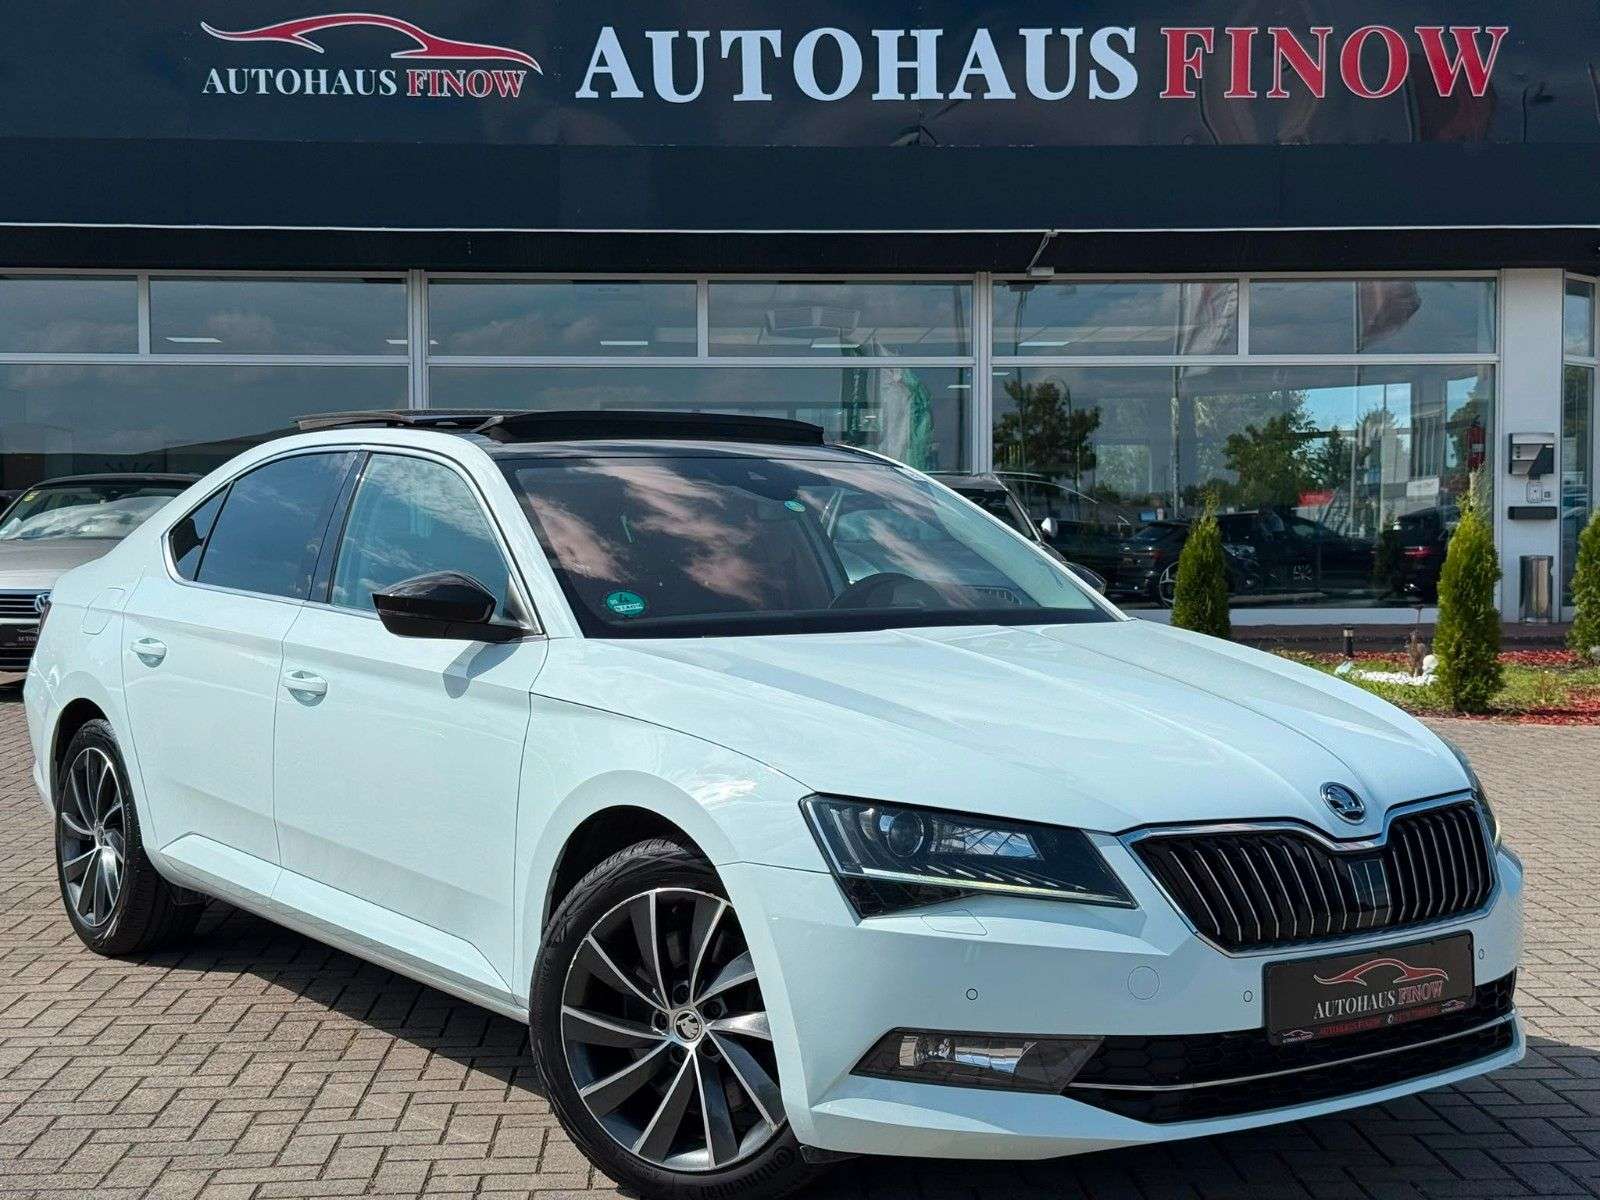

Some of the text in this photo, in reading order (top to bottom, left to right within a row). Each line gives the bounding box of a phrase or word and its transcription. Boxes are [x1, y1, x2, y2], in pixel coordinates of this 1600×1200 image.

[202, 68, 528, 98] AUTOHAUS FINOW
[575, 25, 1509, 103] AUTOHAUS FINOW
[1314, 991, 1396, 1019] AUTOHAUS
[1398, 981, 1444, 1004] FINOW
